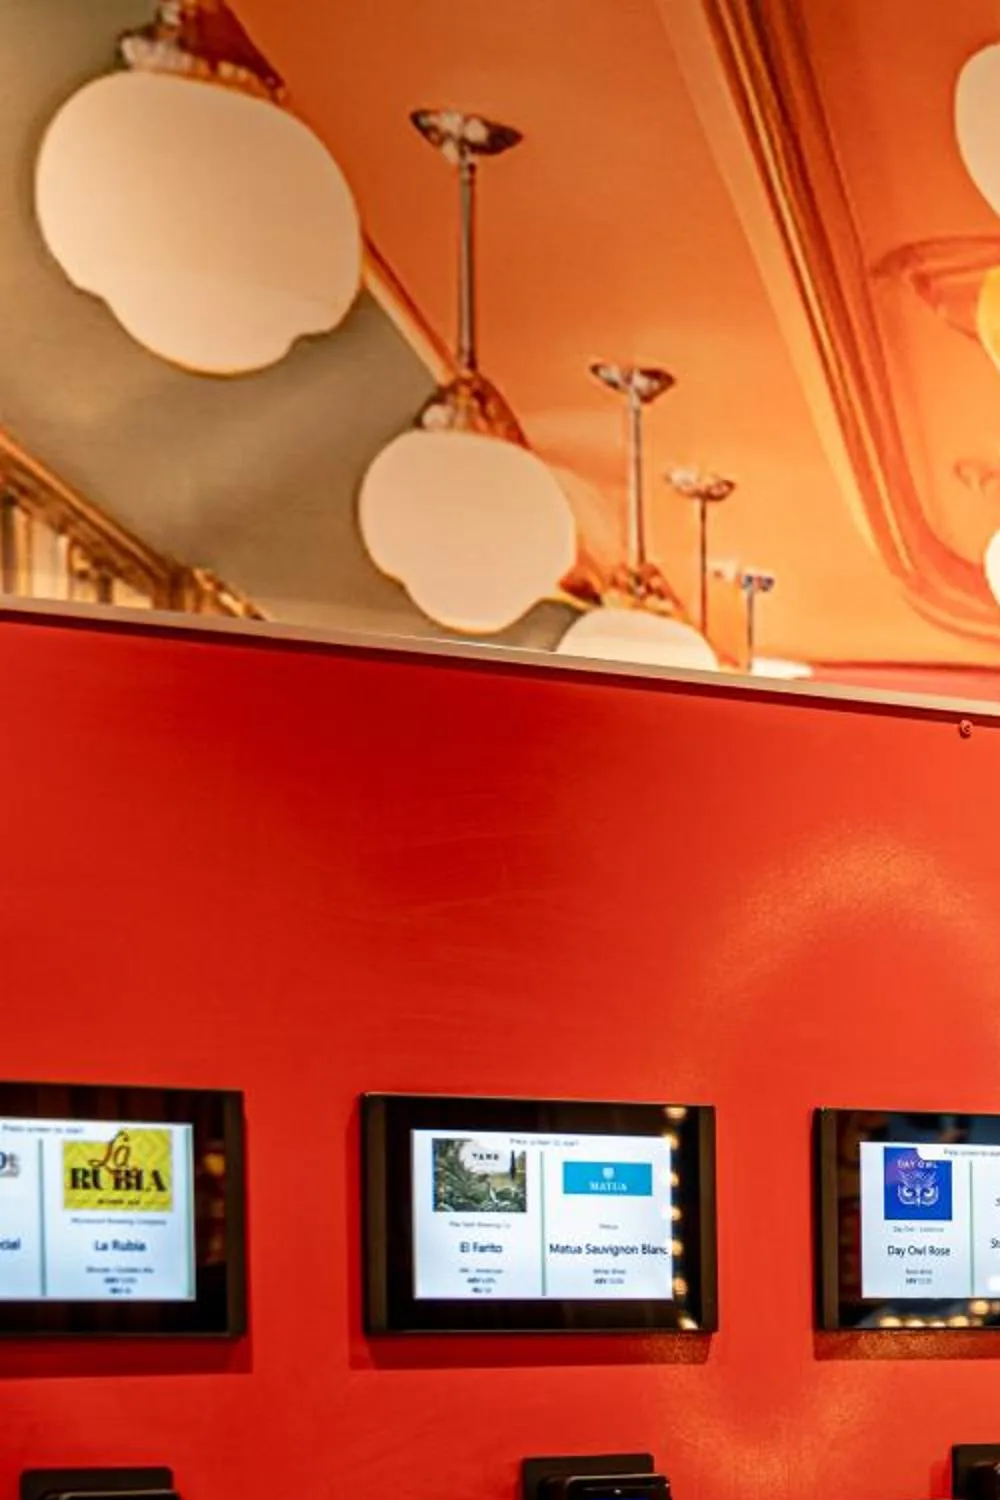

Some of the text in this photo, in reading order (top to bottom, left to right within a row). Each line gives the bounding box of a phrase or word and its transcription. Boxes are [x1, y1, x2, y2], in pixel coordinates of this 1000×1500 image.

[89, 1130, 131, 1174] La
[95, 1239, 146, 1251] La Rubia
[549, 1243, 668, 1257] Matua Sauvignon Blanc
[887, 1245, 907, 1257] Day
